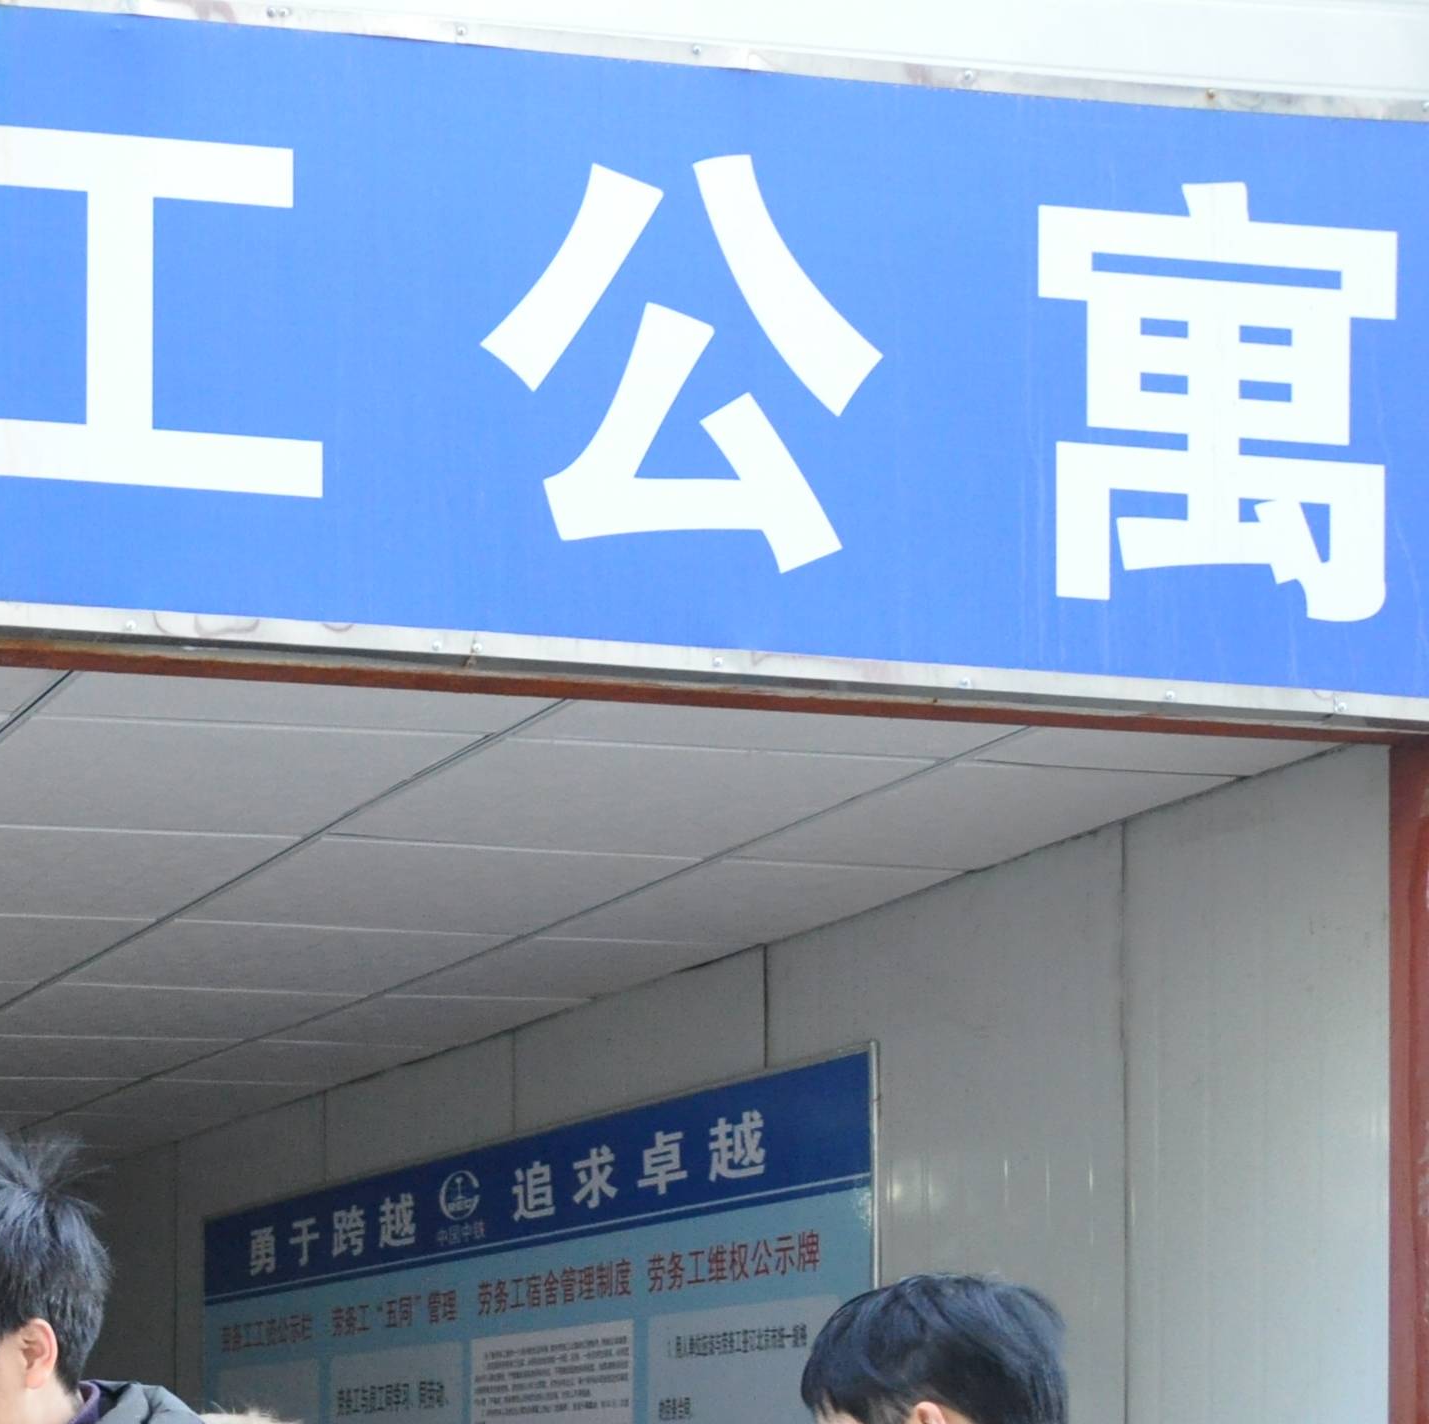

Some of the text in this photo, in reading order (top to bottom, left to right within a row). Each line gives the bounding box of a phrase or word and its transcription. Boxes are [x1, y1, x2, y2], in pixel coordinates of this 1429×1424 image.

[248, 1110, 768, 1277] 勇于跨越 追求卓越
[477, 1262, 634, 1317] 劳务工宿舍管理制度
[647, 1229, 821, 1292] 劳务工维权公示牌
